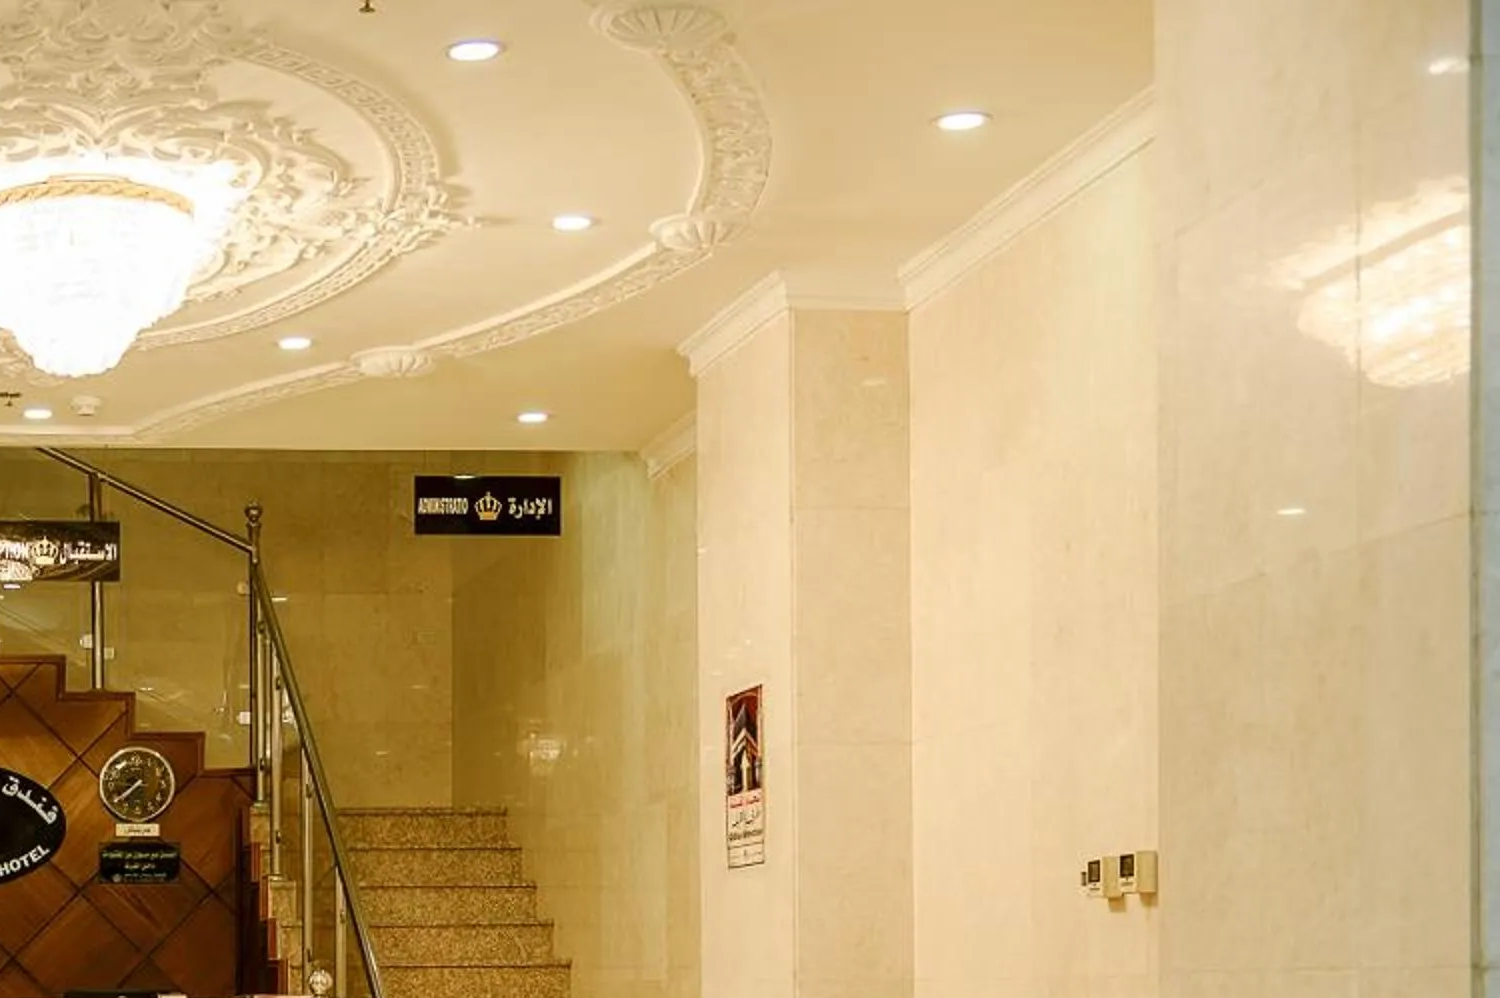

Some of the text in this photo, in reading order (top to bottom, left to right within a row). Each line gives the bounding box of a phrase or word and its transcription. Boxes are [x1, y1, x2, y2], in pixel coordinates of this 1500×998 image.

[508, 497, 553, 520] الإدارة
[59, 541, 117, 565] الاستقبال
[1, 776, 59, 825] فندق
